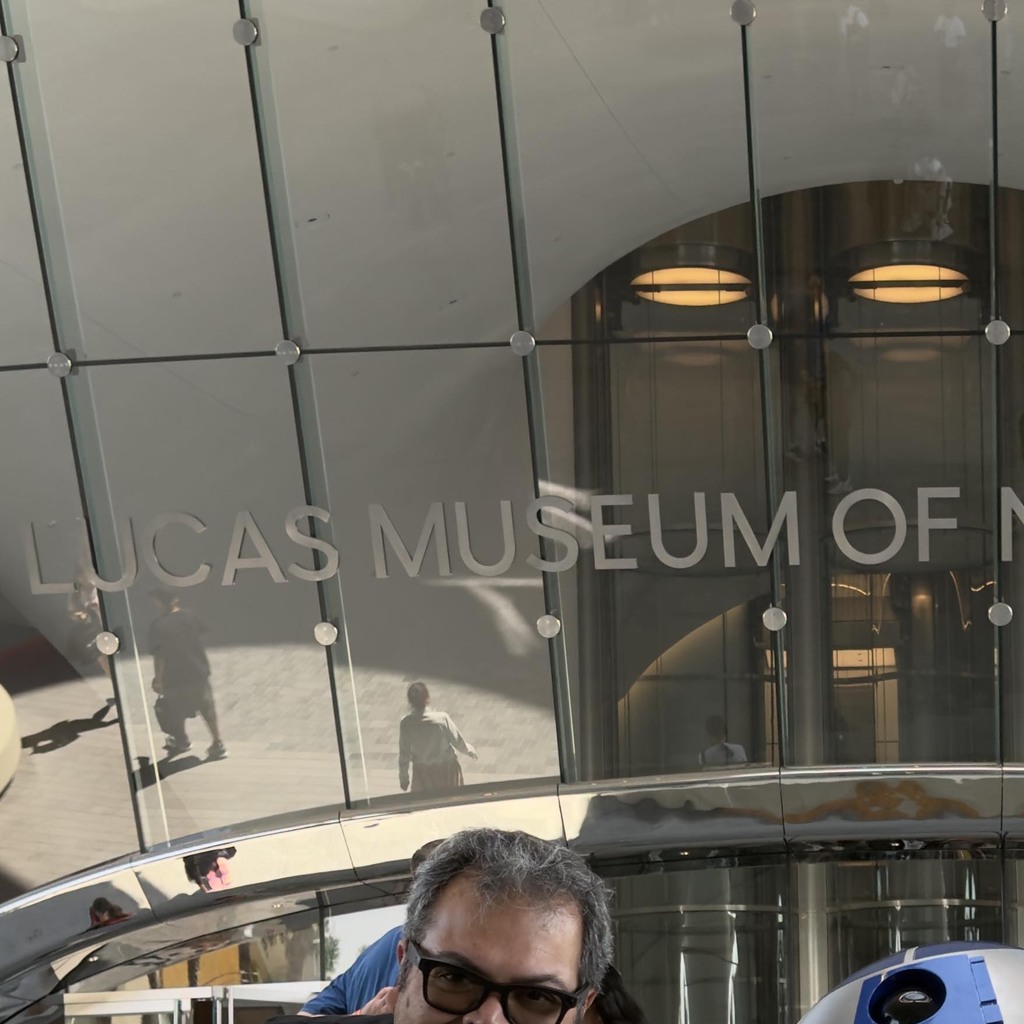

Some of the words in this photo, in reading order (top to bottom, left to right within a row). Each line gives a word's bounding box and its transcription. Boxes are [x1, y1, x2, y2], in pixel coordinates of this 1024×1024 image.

[29, 504, 340, 595] LUCAS
[367, 490, 800, 580] MUSEUM
[831, 487, 961, 565] OF
